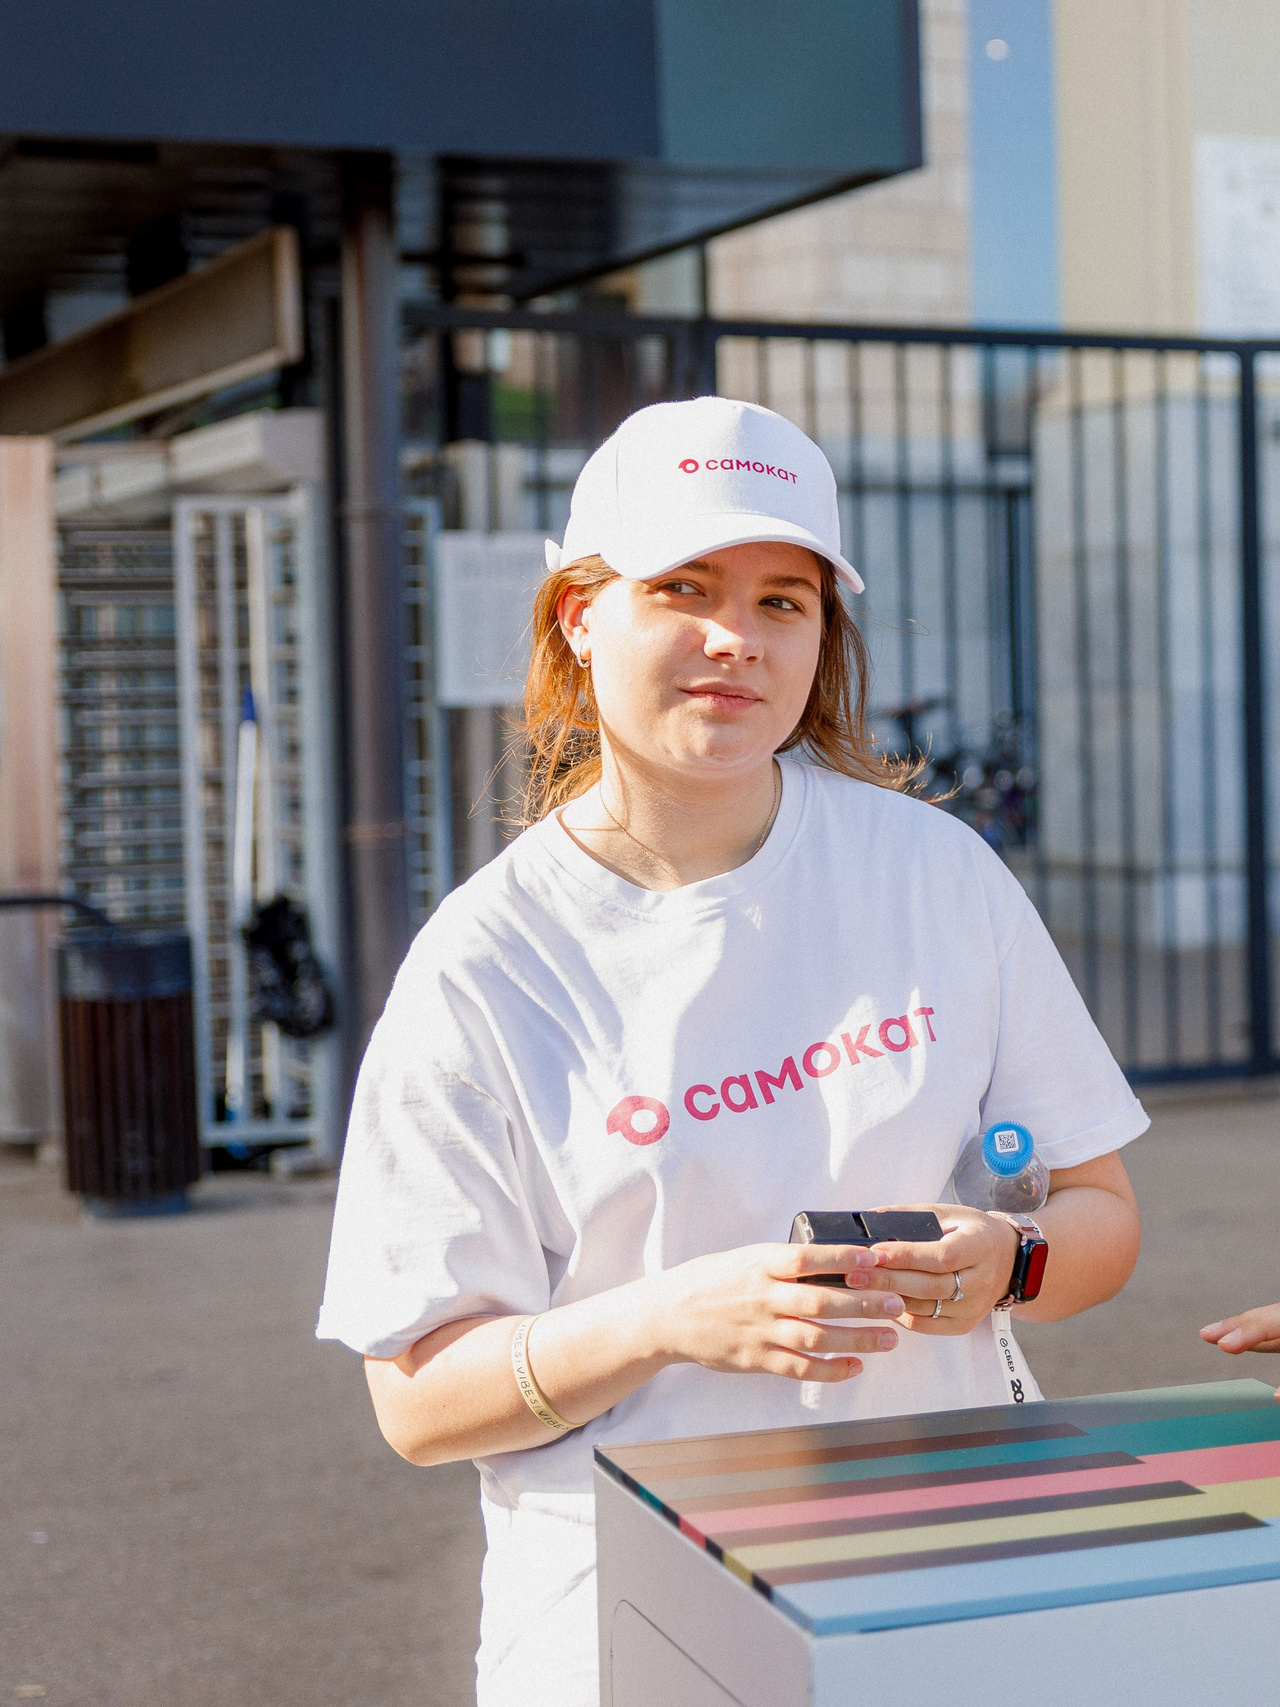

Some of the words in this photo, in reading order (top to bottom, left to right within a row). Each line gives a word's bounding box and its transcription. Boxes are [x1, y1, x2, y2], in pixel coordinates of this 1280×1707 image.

[705, 458, 798, 484] самокат
[683, 1006, 937, 1121] самокат
[1004, 1349, 1015, 1373] СБЕР
